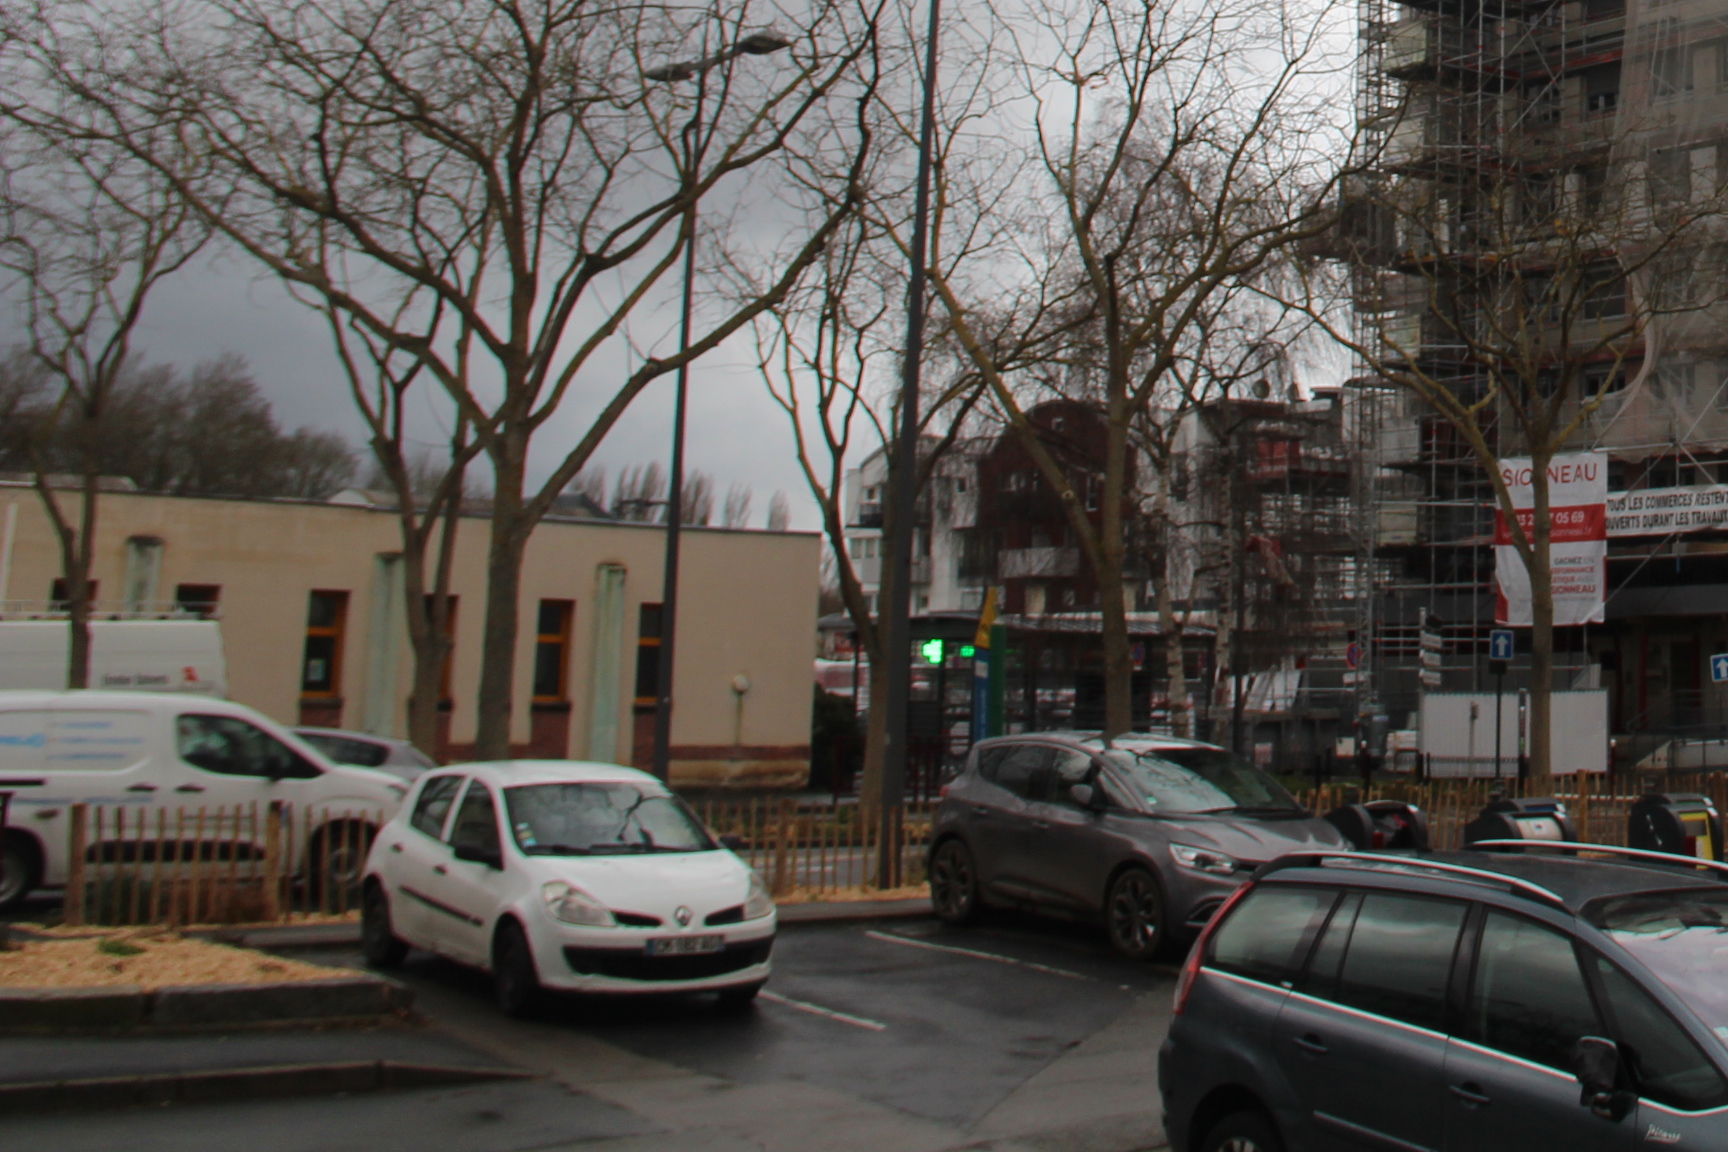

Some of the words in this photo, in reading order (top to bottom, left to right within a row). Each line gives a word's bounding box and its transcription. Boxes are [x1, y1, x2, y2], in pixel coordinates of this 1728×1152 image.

[1503, 463, 1597, 487] SIONEAU
[1628, 496, 1643, 510] LES
[1645, 492, 1693, 509] COMMERCES
[1642, 513, 1674, 528] DURANT
[1675, 512, 1690, 526] LES
[1691, 509, 1728, 525] TRAVAUX
